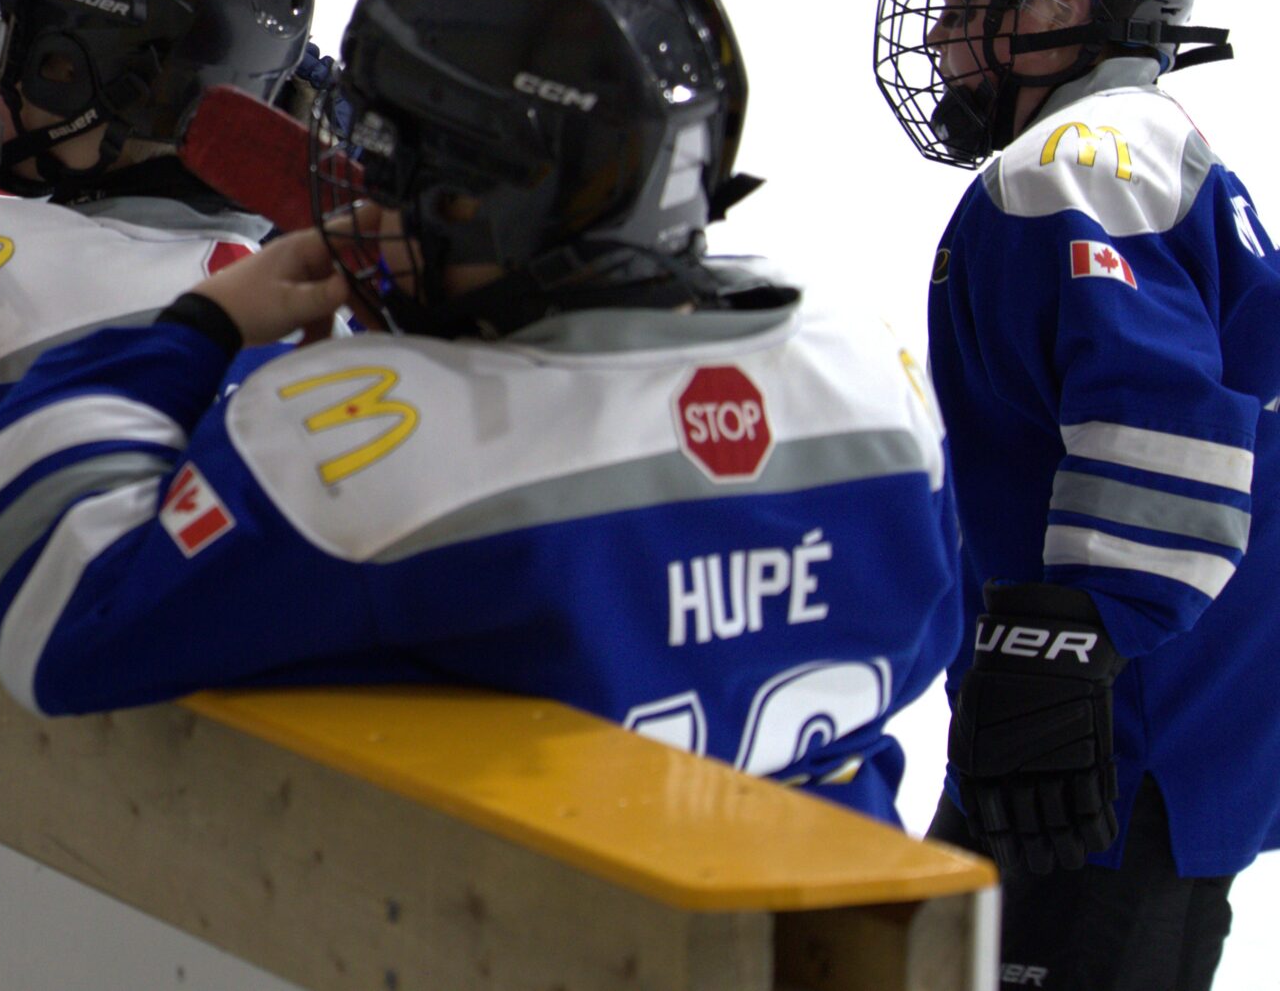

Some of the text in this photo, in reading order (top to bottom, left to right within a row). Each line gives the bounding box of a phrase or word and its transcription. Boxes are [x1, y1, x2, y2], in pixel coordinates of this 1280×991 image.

[513, 71, 598, 111] CCM
[48, 108, 99, 140] BAUER
[685, 399, 761, 442] STOP
[668, 530, 832, 647] HUPÉ
